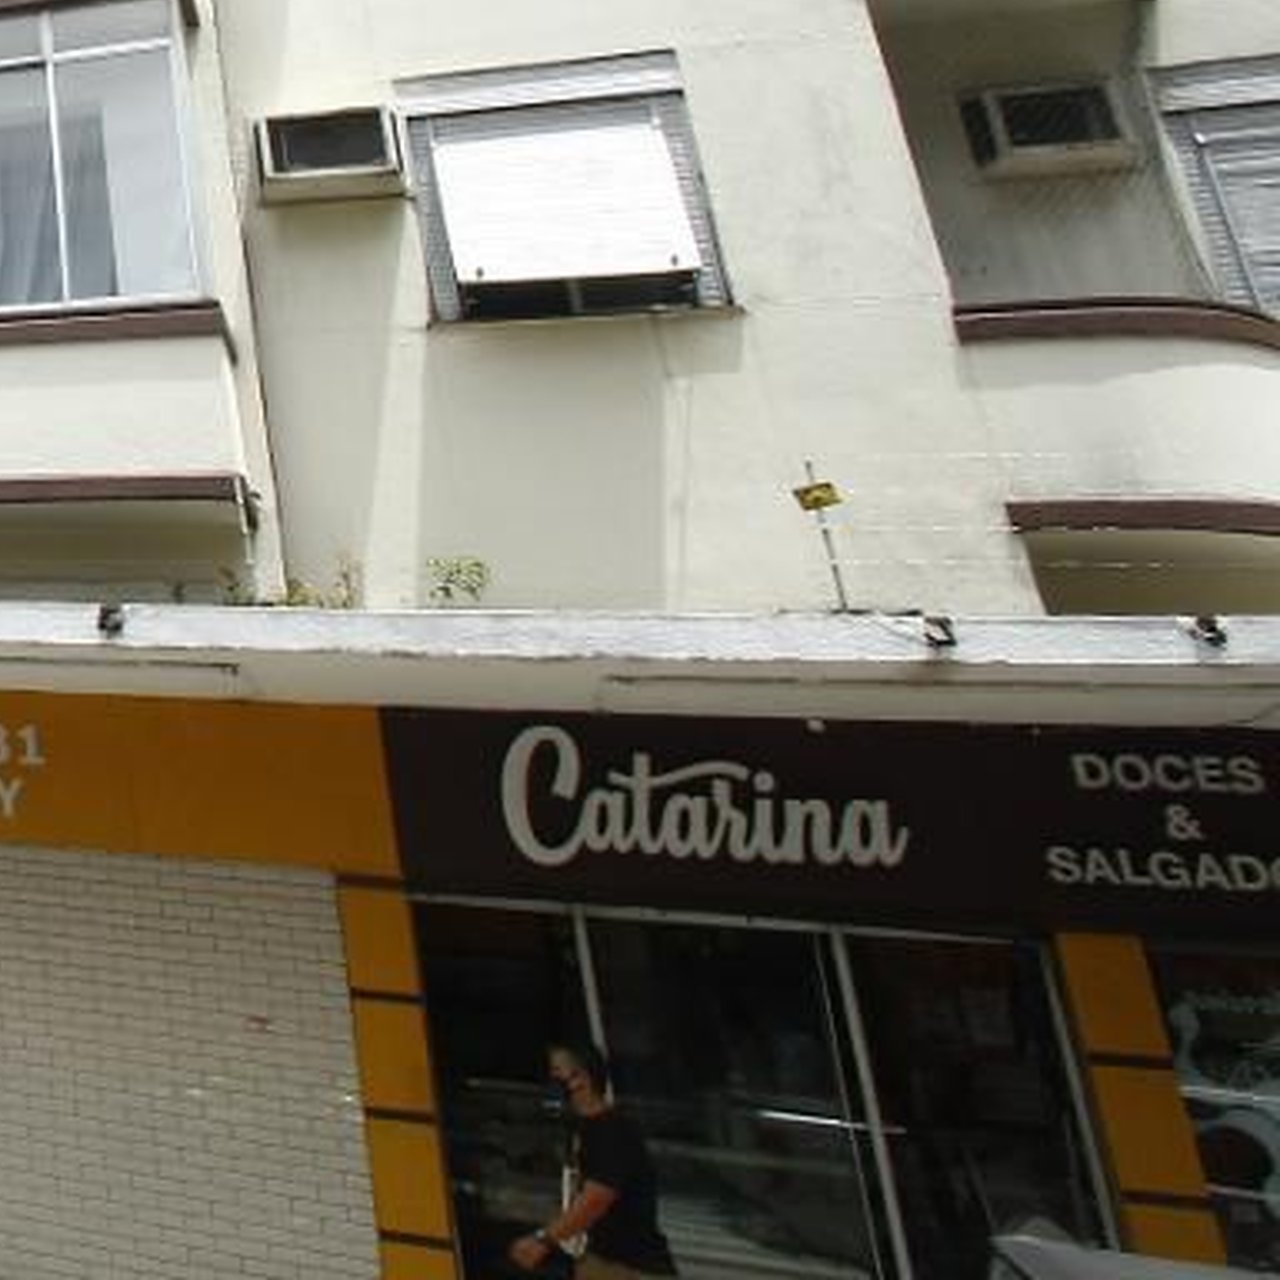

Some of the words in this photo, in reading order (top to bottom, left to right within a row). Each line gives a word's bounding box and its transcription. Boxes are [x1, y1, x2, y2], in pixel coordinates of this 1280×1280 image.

[1071, 753, 1265, 794] DOCES
[501, 724, 909, 866] Catarina
[1165, 804, 1204, 841] &
